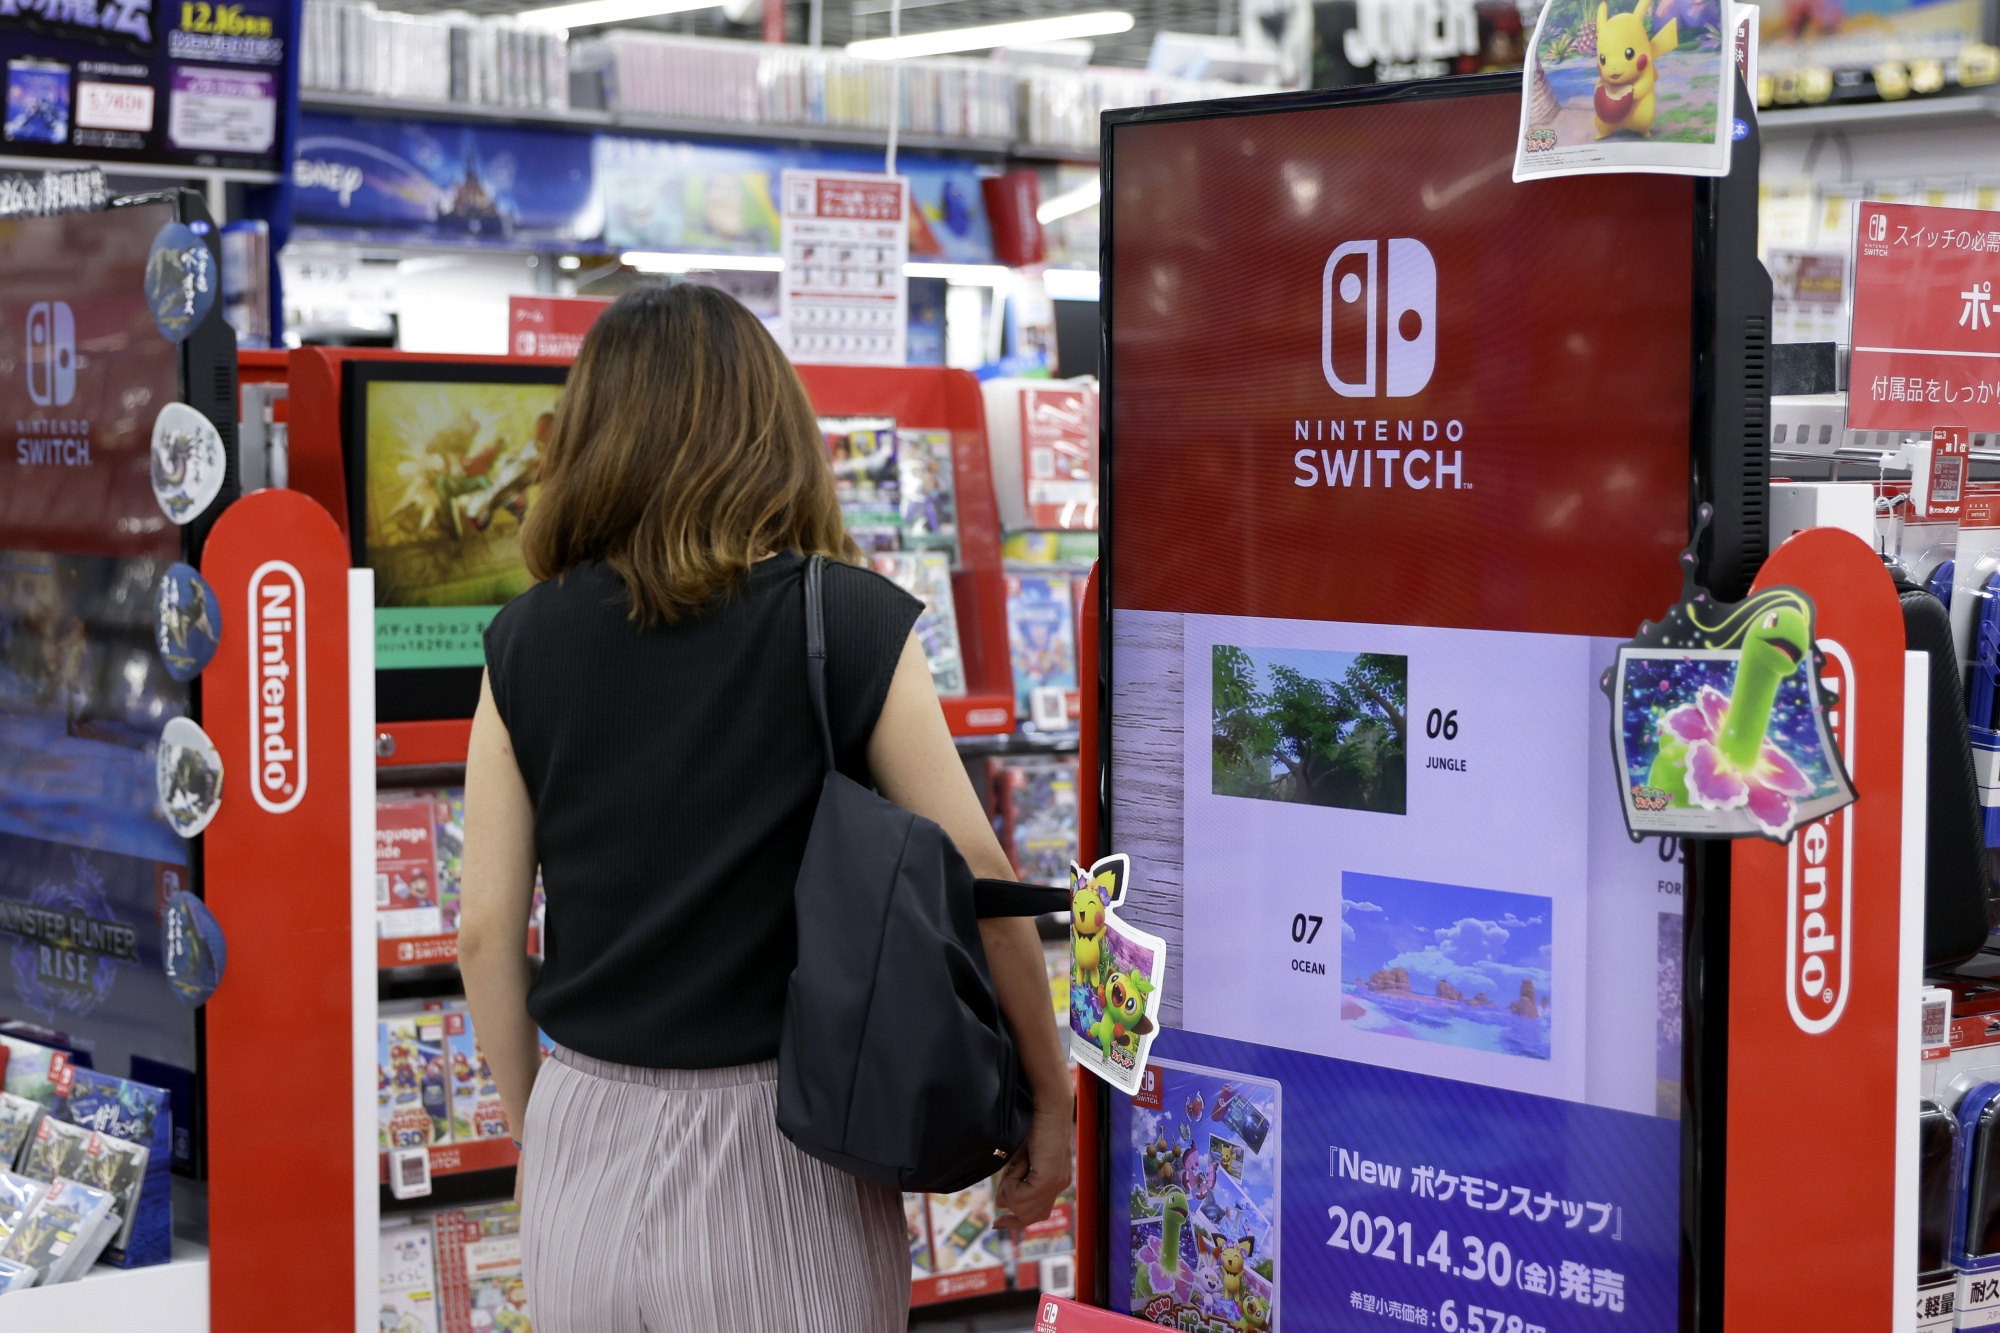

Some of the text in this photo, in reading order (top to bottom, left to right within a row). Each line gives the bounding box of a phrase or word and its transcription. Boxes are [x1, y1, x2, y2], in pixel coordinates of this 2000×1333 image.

[1893, 225, 2000, 253] スイッチの必需
[1863, 249, 1888, 257] SWITCH
[16, 419, 90, 435] NINTENDO
[1295, 419, 1463, 442] NINTENDO
[16, 438, 90, 466] SWITCH
[1945, 433, 1967, 453] 第1位
[1293, 448, 1463, 490] SWITCH
[262, 584, 294, 792] Nintendo
[1426, 708, 1459, 741] 06
[1425, 757, 1467, 772] JUNGLE
[1658, 880, 1682, 895] FOR
[69, 917, 136, 958] HUNTER
[1292, 913, 1323, 944] 07
[40, 945, 89, 984] RISE
[1291, 959, 1325, 975] OCEAN
[1136, 1094, 1159, 1105] SWITCH
[399, 1130, 425, 1148] 3D
[1329, 1146, 1622, 1241] 『New ポケモンスナップ』
[1326, 1205, 1625, 1313] 2021.4.30(金)発売
[1970, 1279, 2000, 1304] 耐久
[1147, 1298, 1172, 1318] New
